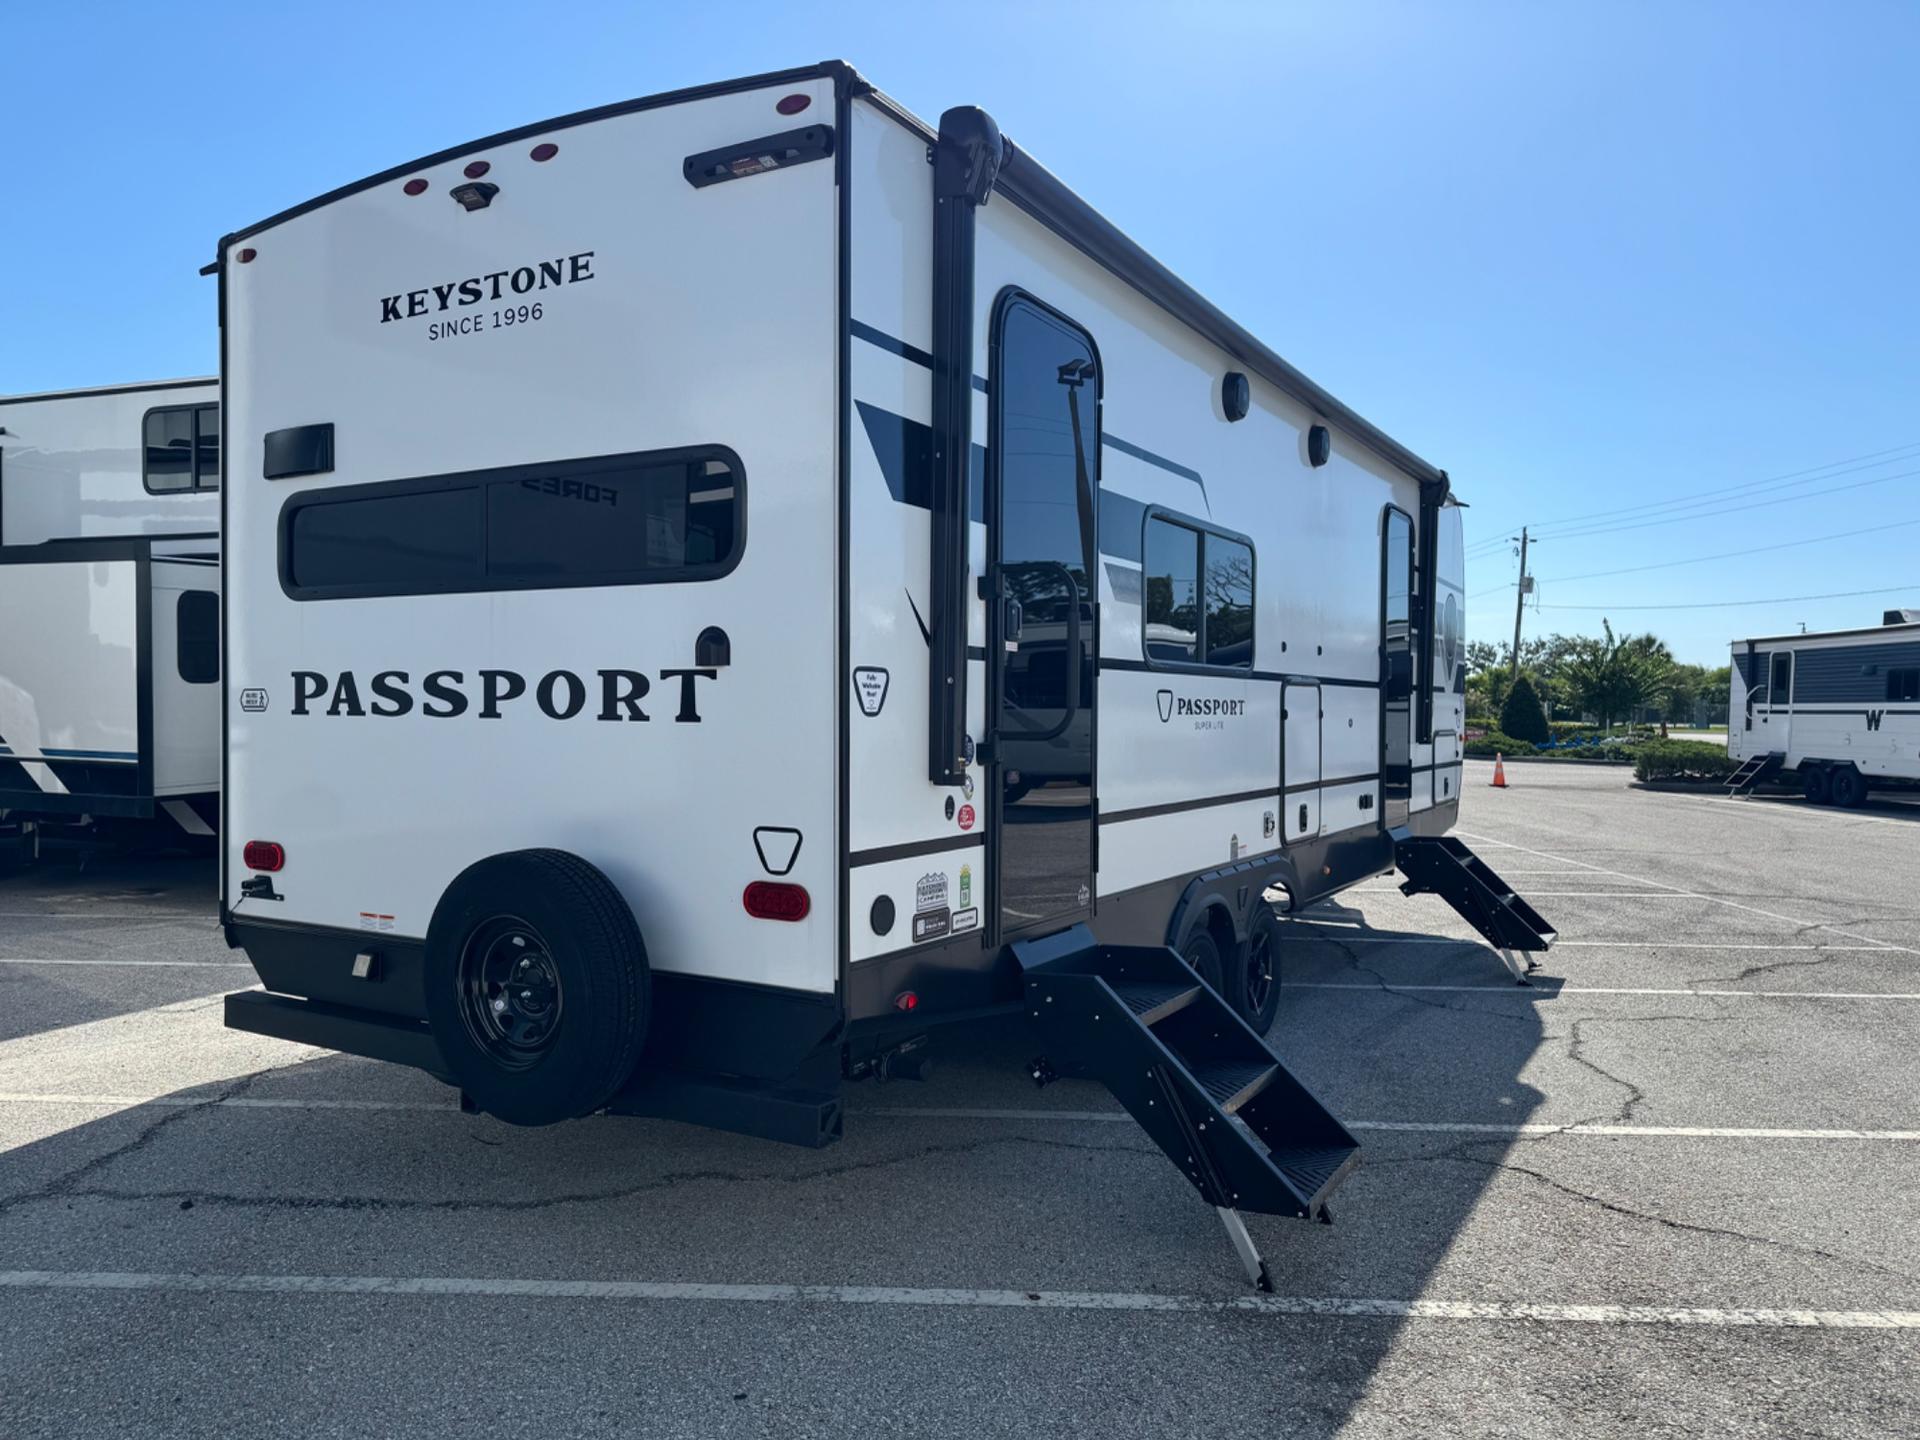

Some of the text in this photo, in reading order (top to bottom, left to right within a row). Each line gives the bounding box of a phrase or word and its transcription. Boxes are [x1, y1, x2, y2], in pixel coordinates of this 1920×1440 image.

[380, 251, 595, 324] KEYSTONE
[428, 302, 543, 341] SINCE 1996
[291, 669, 718, 723] PASSPORT
[1177, 697, 1245, 716] PASSPORT
[1194, 720, 1212, 730] SUPER
[1865, 709, 1884, 731] W
